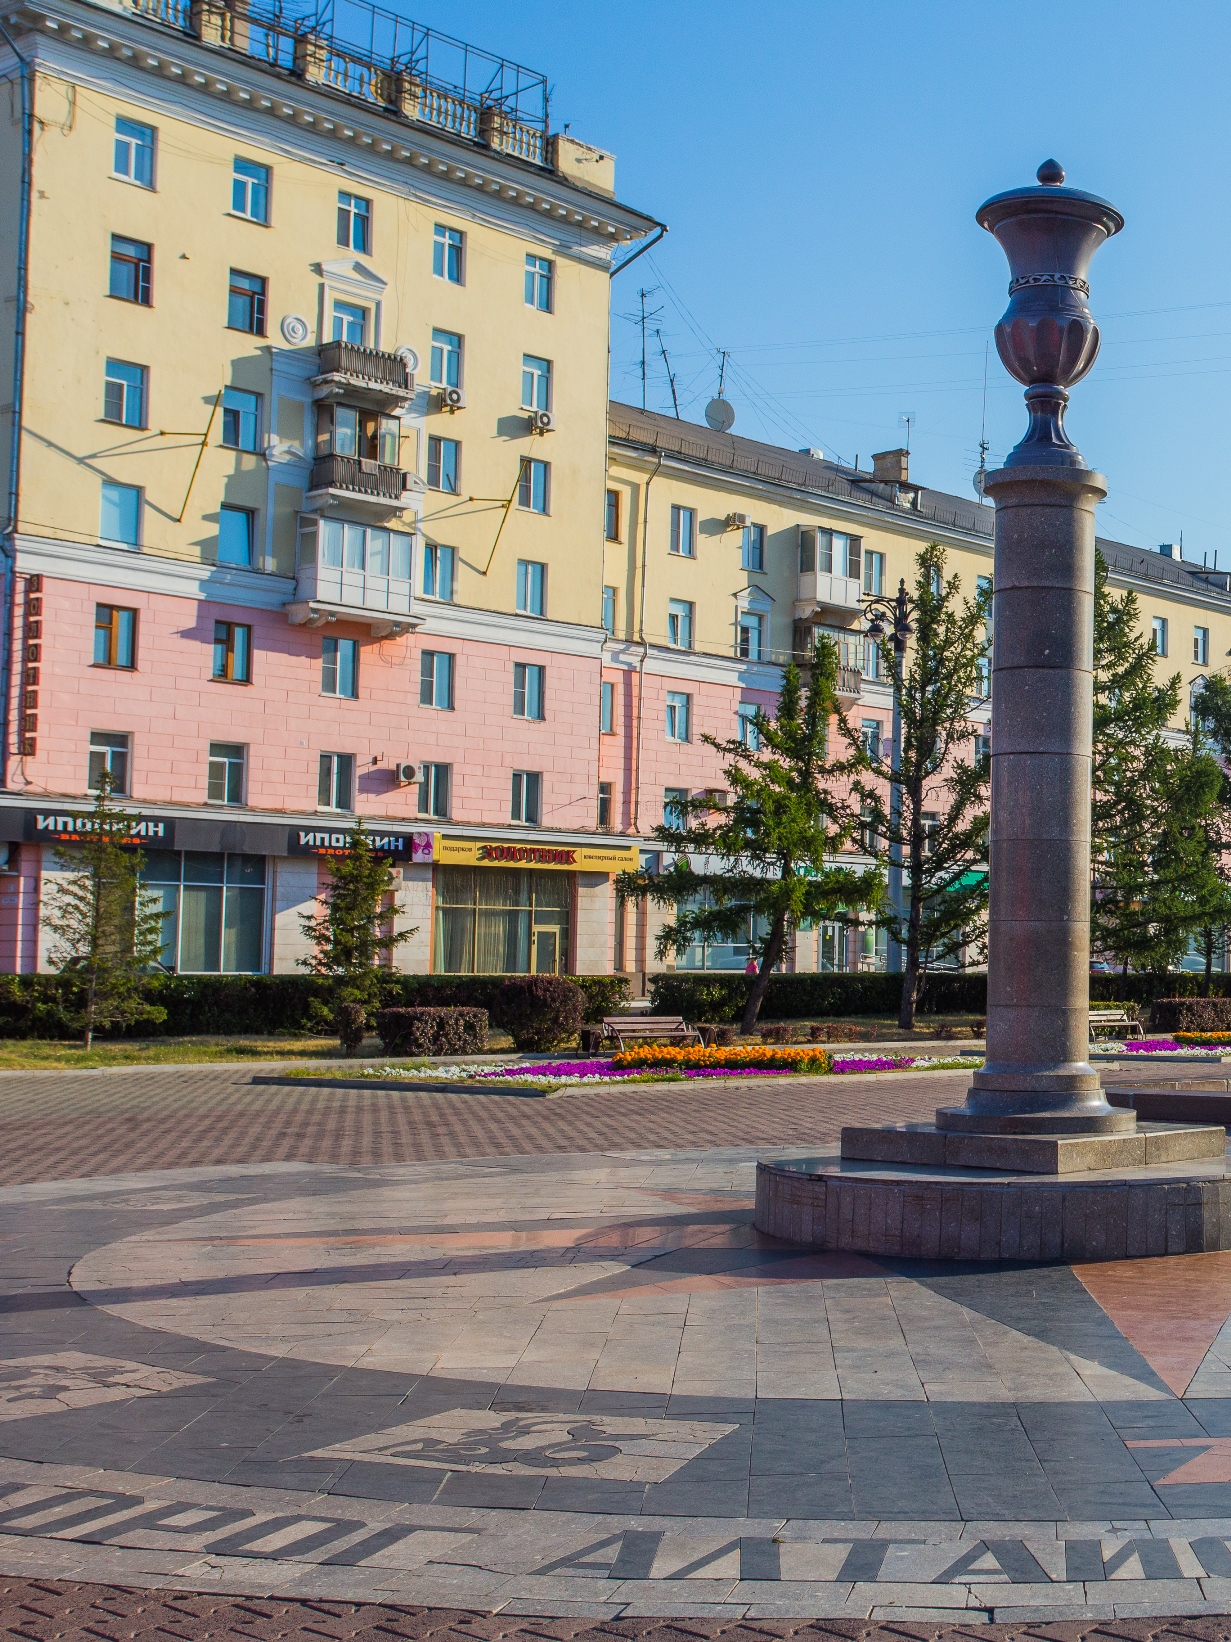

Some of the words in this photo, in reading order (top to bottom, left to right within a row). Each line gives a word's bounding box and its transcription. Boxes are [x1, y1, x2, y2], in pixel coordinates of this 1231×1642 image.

[442, 845, 473, 853] подарков
[482, 844, 579, 864] ЗОЛОТНИК
[0, 1481, 482, 1567] ОРОГ
